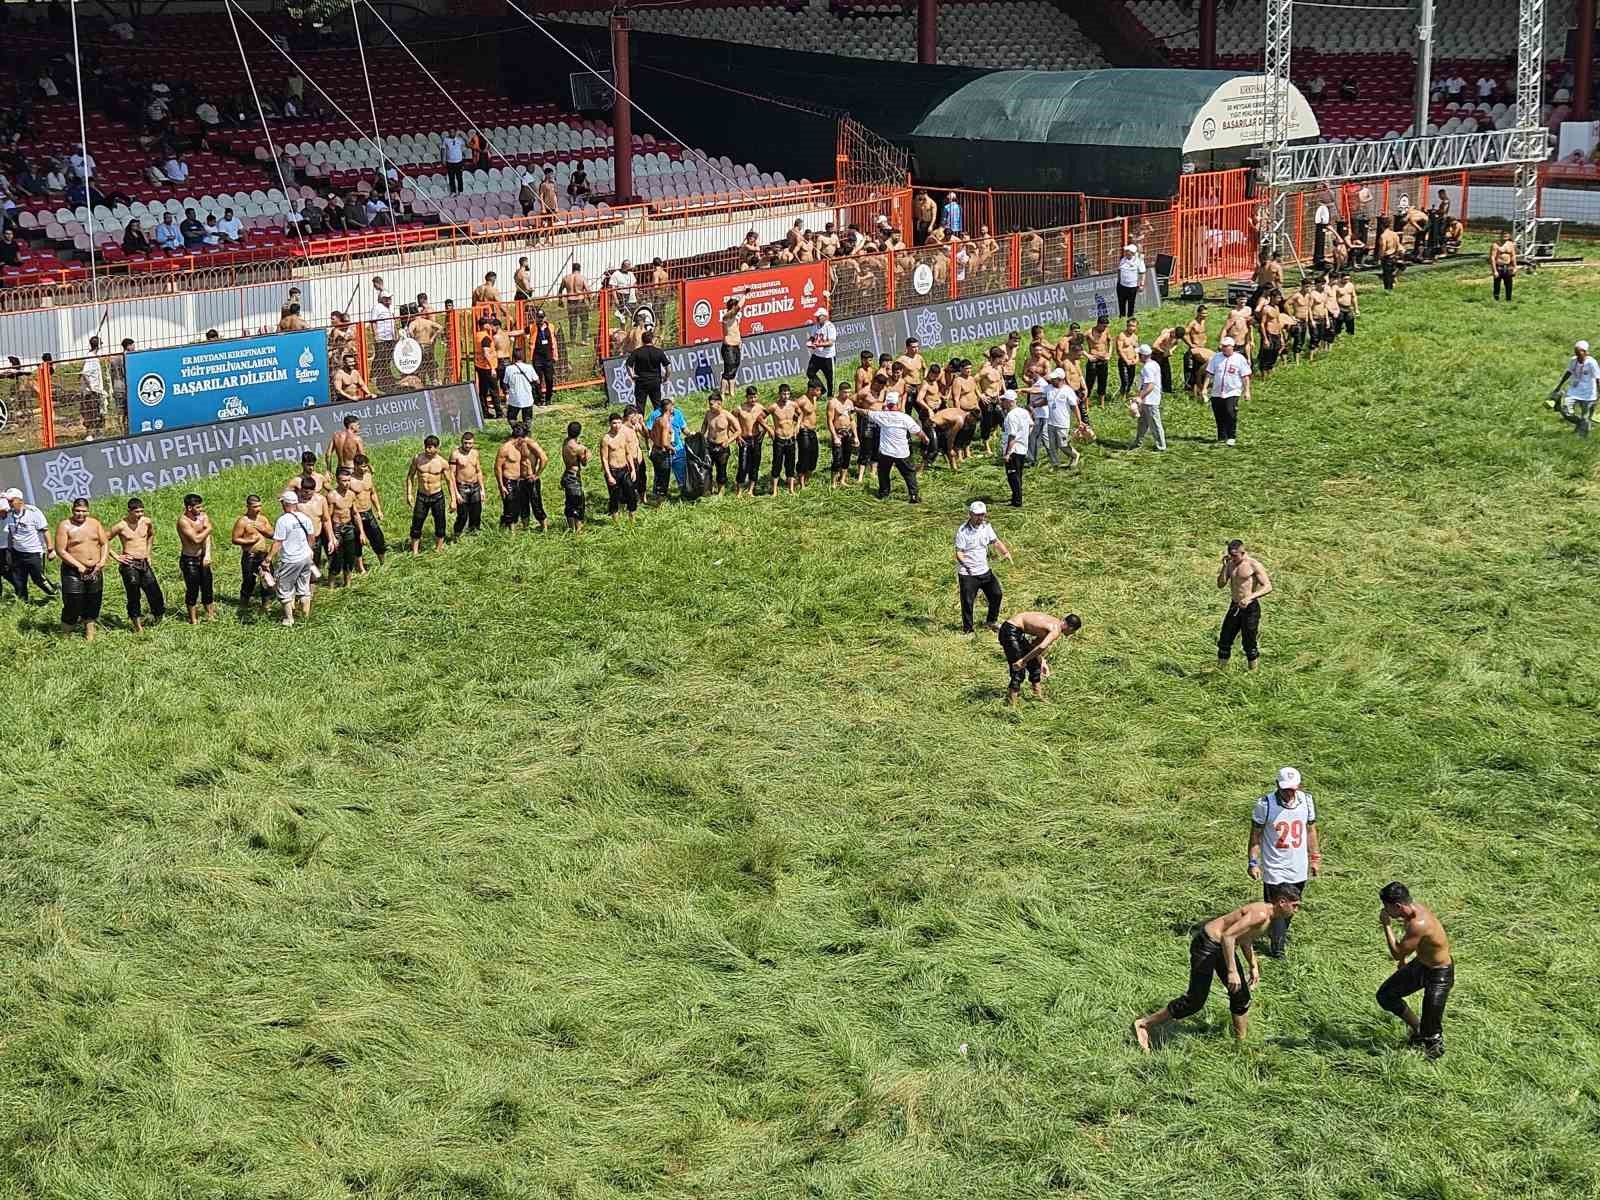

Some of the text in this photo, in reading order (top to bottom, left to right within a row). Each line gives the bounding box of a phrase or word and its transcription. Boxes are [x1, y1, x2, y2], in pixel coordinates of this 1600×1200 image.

[743, 295, 796, 319] GELDİNİZ
[946, 300, 977, 322] TÜM
[978, 287, 1069, 317] PEHLİVANLARA
[173, 366, 288, 397] BAŞARILAR DİLERİM
[101, 440, 156, 469] TÜM
[160, 414, 325, 460] PEHLİVANLARA
[375, 397, 421, 417] AKBIYIK
[375, 417, 426, 437] Belediye
[1275, 820, 1304, 849] 29
